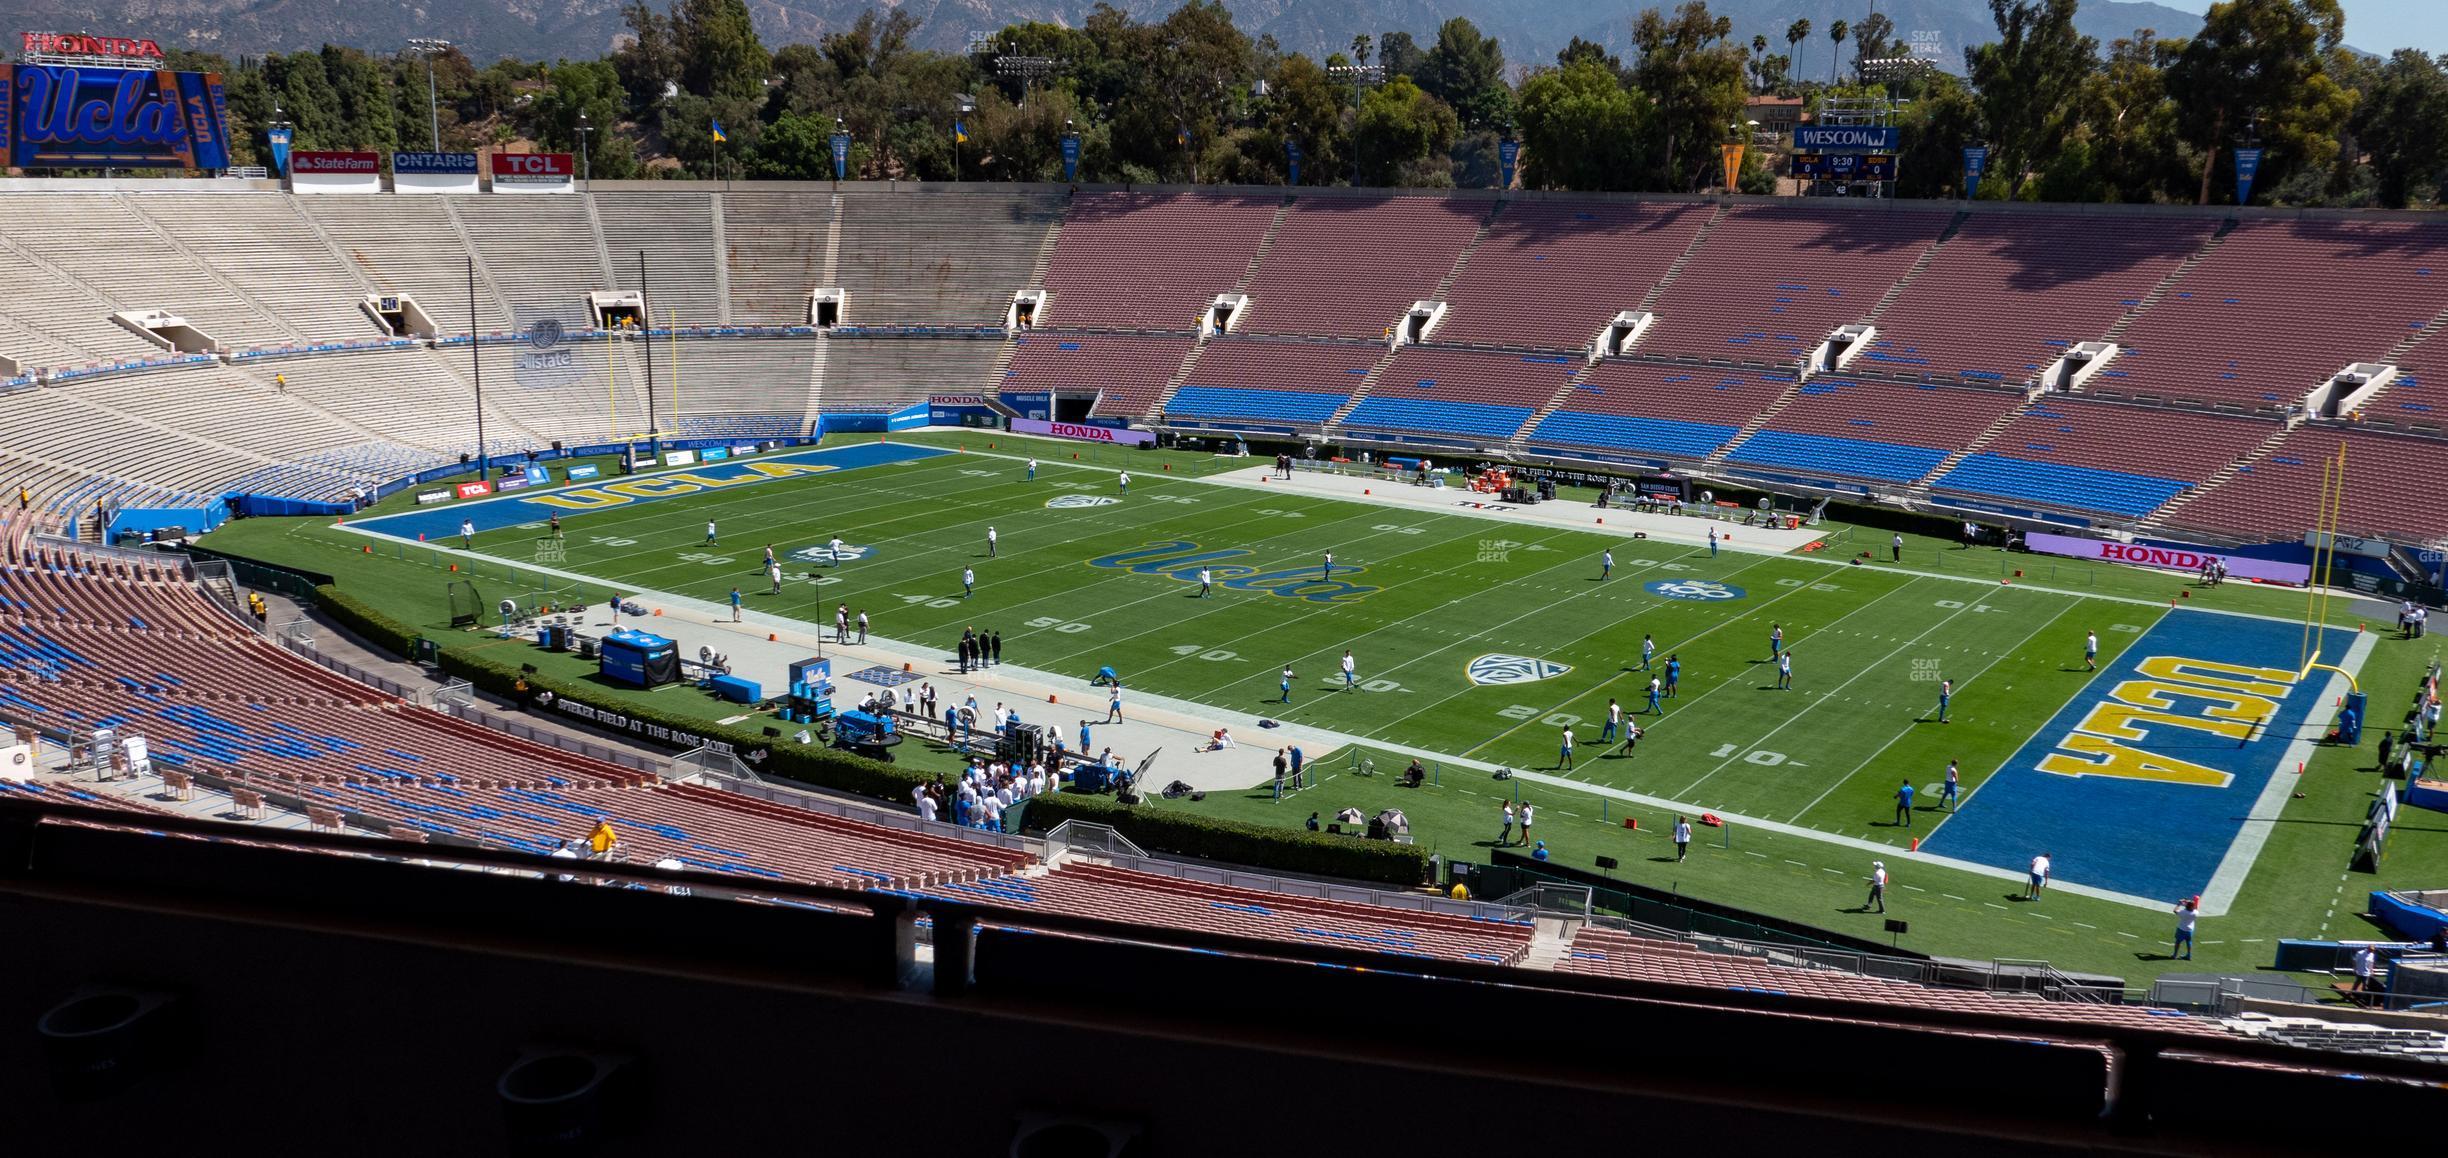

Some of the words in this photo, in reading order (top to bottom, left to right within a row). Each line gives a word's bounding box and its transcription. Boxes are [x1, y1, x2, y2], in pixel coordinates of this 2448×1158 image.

[21, 32, 165, 58] HONDA
[188, 96, 211, 143] UCLA
[1803, 131, 1867, 145] WESCOM
[396, 154, 476, 167] ONTARIO
[506, 156, 559, 172] TCL
[1833, 157, 1853, 166] 9:30
[1874, 166, 1880, 174] 0
[381, 298, 398, 310] 40
[931, 396, 982, 404] HONDA
[1051, 424, 1114, 440] HONDA
[688, 440, 722, 448] WESCOM
[1495, 465, 1526, 474] SPIKER
[1529, 467, 1553, 477] FIELD
[1568, 472, 1585, 480] THE
[1587, 474, 1607, 483] ROSE
[1609, 477, 1631, 486] BOWL
[462, 485, 488, 496] TCL
[519, 462, 839, 509] UCLA
[1084, 541, 1384, 603] Ucla
[1657, 582, 1735, 599] 100
[1660, 591, 1707, 601] YEARS
[1024, 617, 1092, 634] 50
[1170, 645, 1237, 661] 40
[1322, 672, 1400, 693] 30
[1496, 704, 1583, 727] 20
[2035, 655, 2302, 788] UCLA
[558, 698, 595, 720] SPIEKER
[597, 710, 627, 728] FIELD
[629, 719, 644, 732] AT
[646, 723, 669, 740] THE
[671, 730, 700, 748] ROSE
[703, 739, 734, 754] BOWL
[1710, 744, 1787, 767] 10
